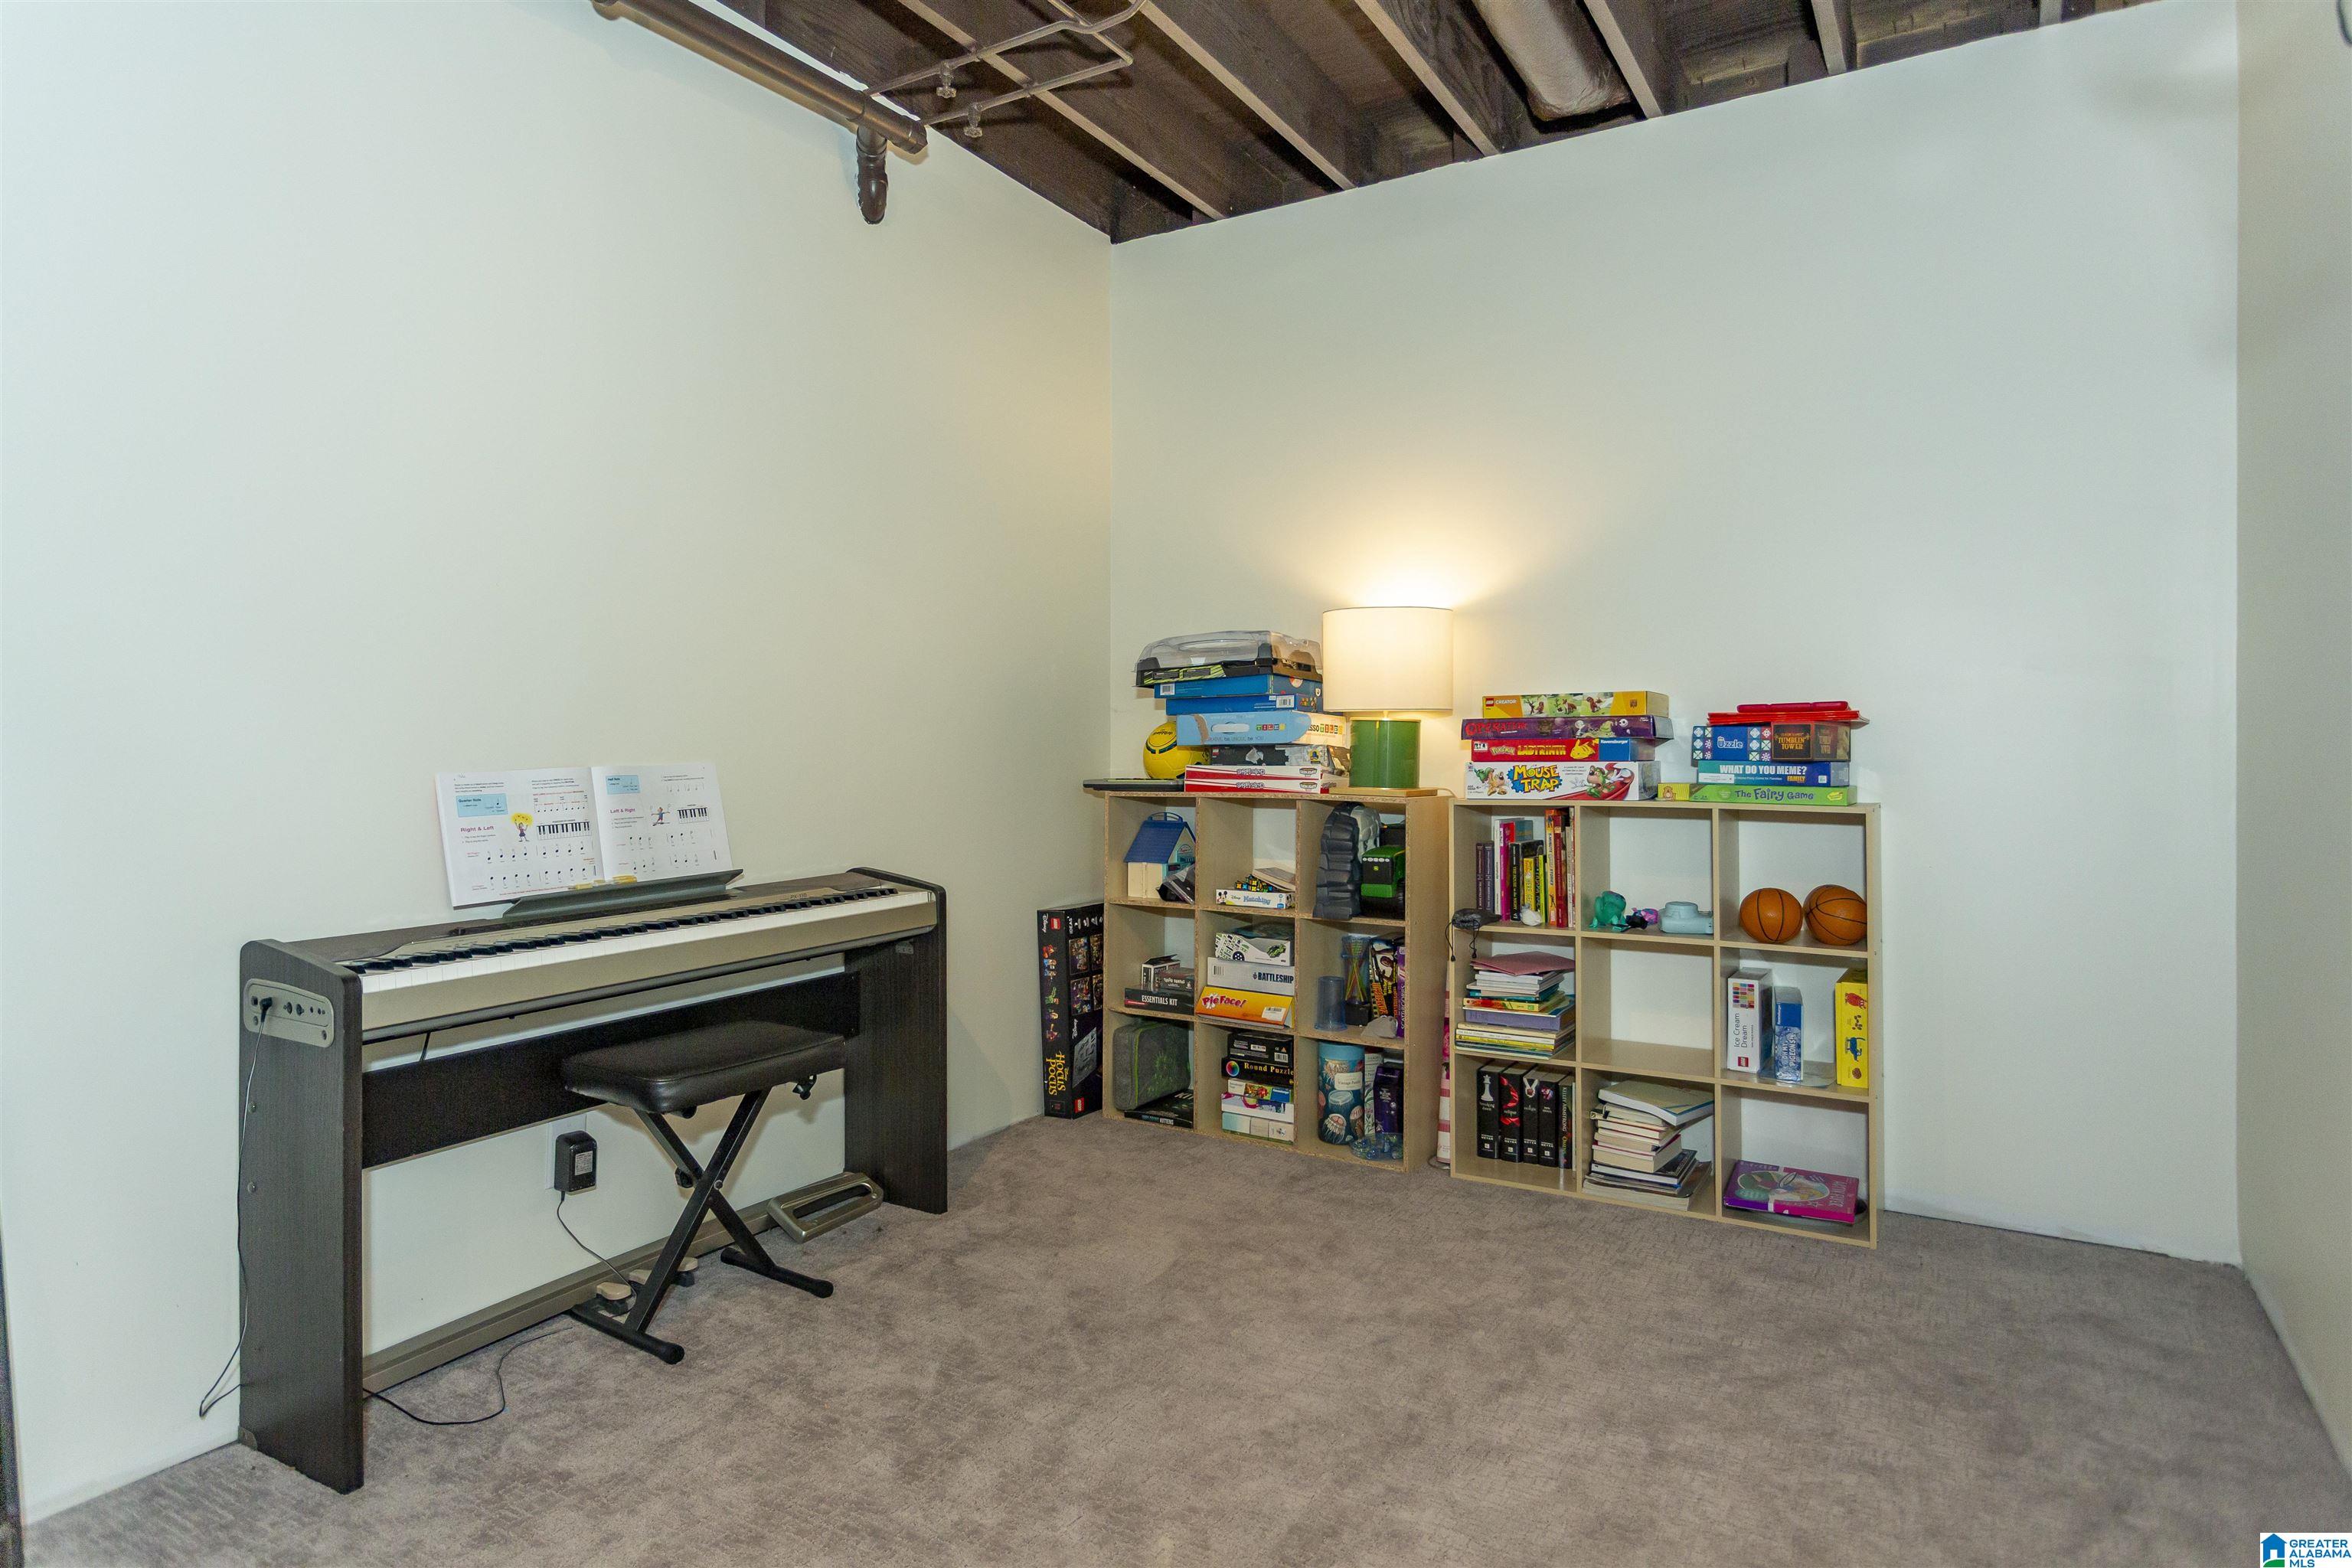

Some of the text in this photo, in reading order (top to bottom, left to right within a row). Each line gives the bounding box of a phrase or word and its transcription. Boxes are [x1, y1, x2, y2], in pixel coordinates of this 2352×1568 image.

[1717, 740, 1743, 749] Uzzle
[1517, 746, 1566, 756] LABYRINTH
[1513, 765, 1559, 780] MOUSE
[1720, 765, 1807, 775] WHAT DO YOU MEME?
[1521, 778, 1559, 792] TRAP
[1735, 788, 1814, 801] The Fairy Game
[1243, 896, 1272, 905] Matching
[1258, 972, 1294, 984] BATTLESHIP
[1142, 995, 1168, 1005] ESSENTIALS
[1202, 995, 1246, 1008] Pie Face!
[1244, 1062, 1294, 1076] Round Puzzle
